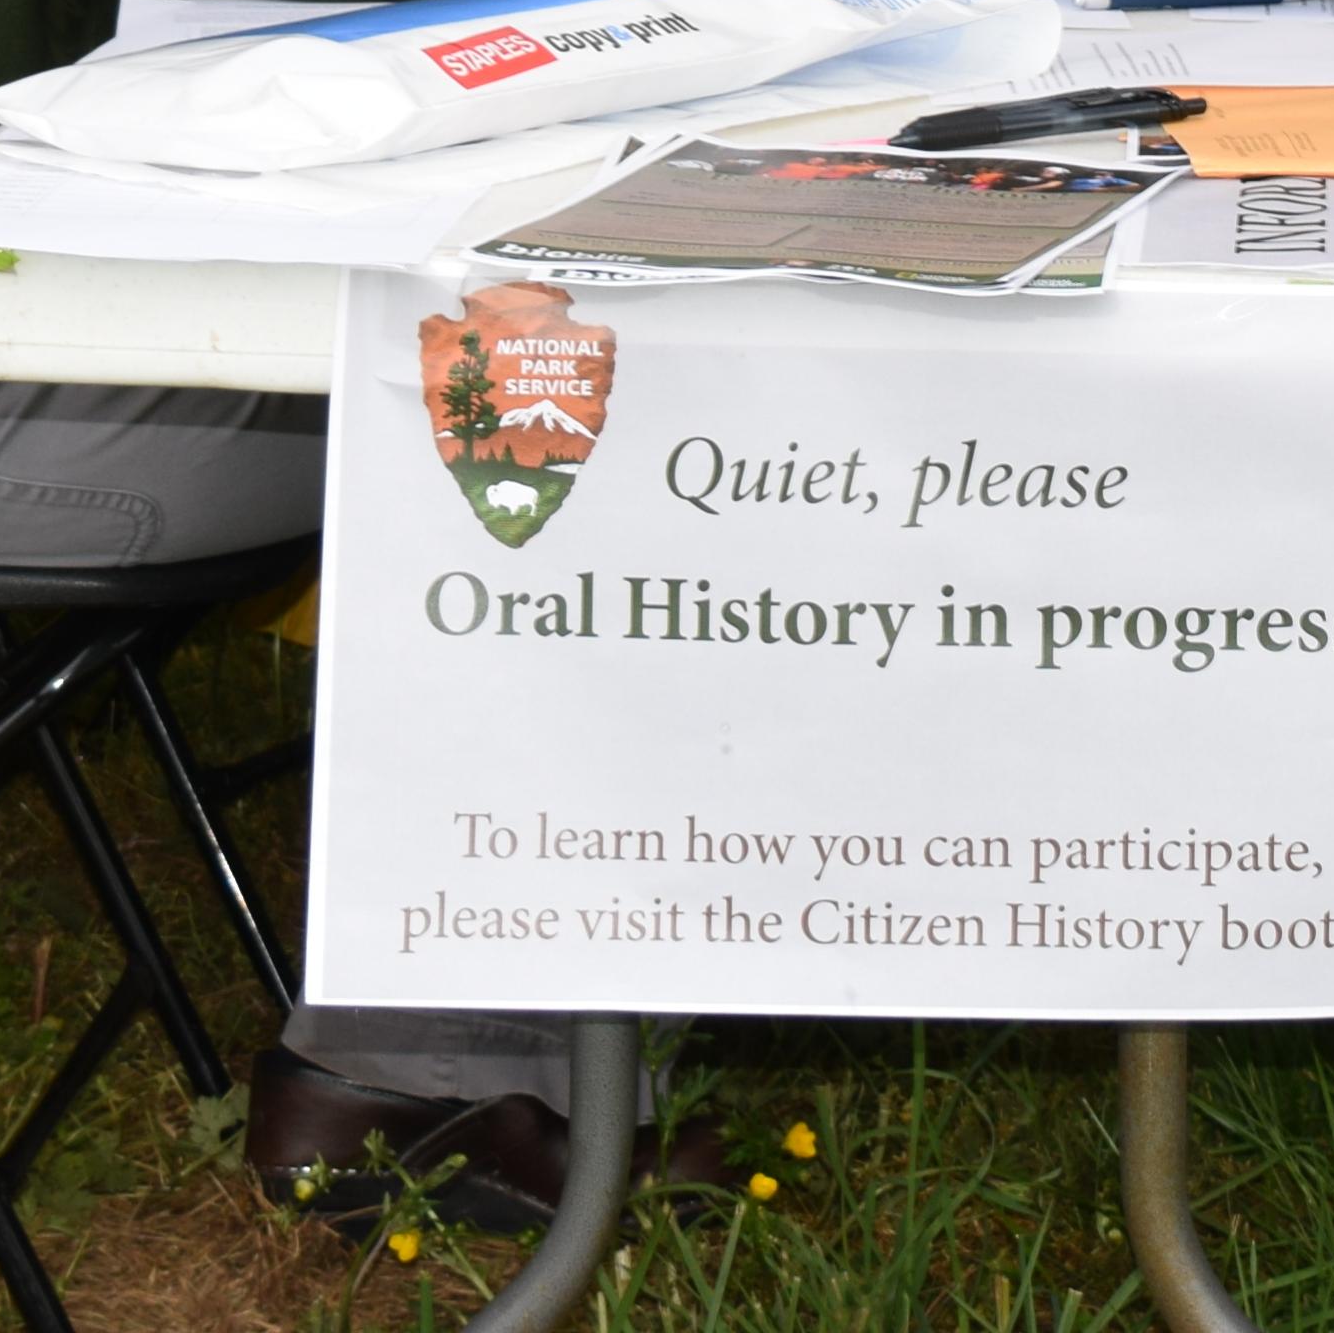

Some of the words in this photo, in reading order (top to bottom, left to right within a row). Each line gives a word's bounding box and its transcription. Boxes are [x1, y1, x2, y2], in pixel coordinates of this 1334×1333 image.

[439, 34, 537, 77] STAPLES
[545, 11, 700, 54] copy&print
[497, 242, 645, 263] bioblitz
[496, 337, 603, 358] NATIONAL
[520, 358, 579, 378] PARK
[504, 378, 594, 397] SERVICE
[666, 437, 878, 515] Quiet,
[901, 439, 1128, 528] please
[426, 571, 598, 637] Oral
[623, 577, 915, 668] History
[936, 584, 1012, 647] in
[454, 812, 518, 859] To
[537, 812, 667, 861] learn
[685, 815, 795, 864] how
[810, 835, 905, 881] you
[924, 836, 1012, 867] can
[1030, 827, 1322, 886] participate,
[399, 890, 559, 953] please
[576, 897, 685, 942] visit
[702, 896, 782, 943] the
[801, 899, 987, 946] Citizen
[1006, 903, 1203, 966] History
